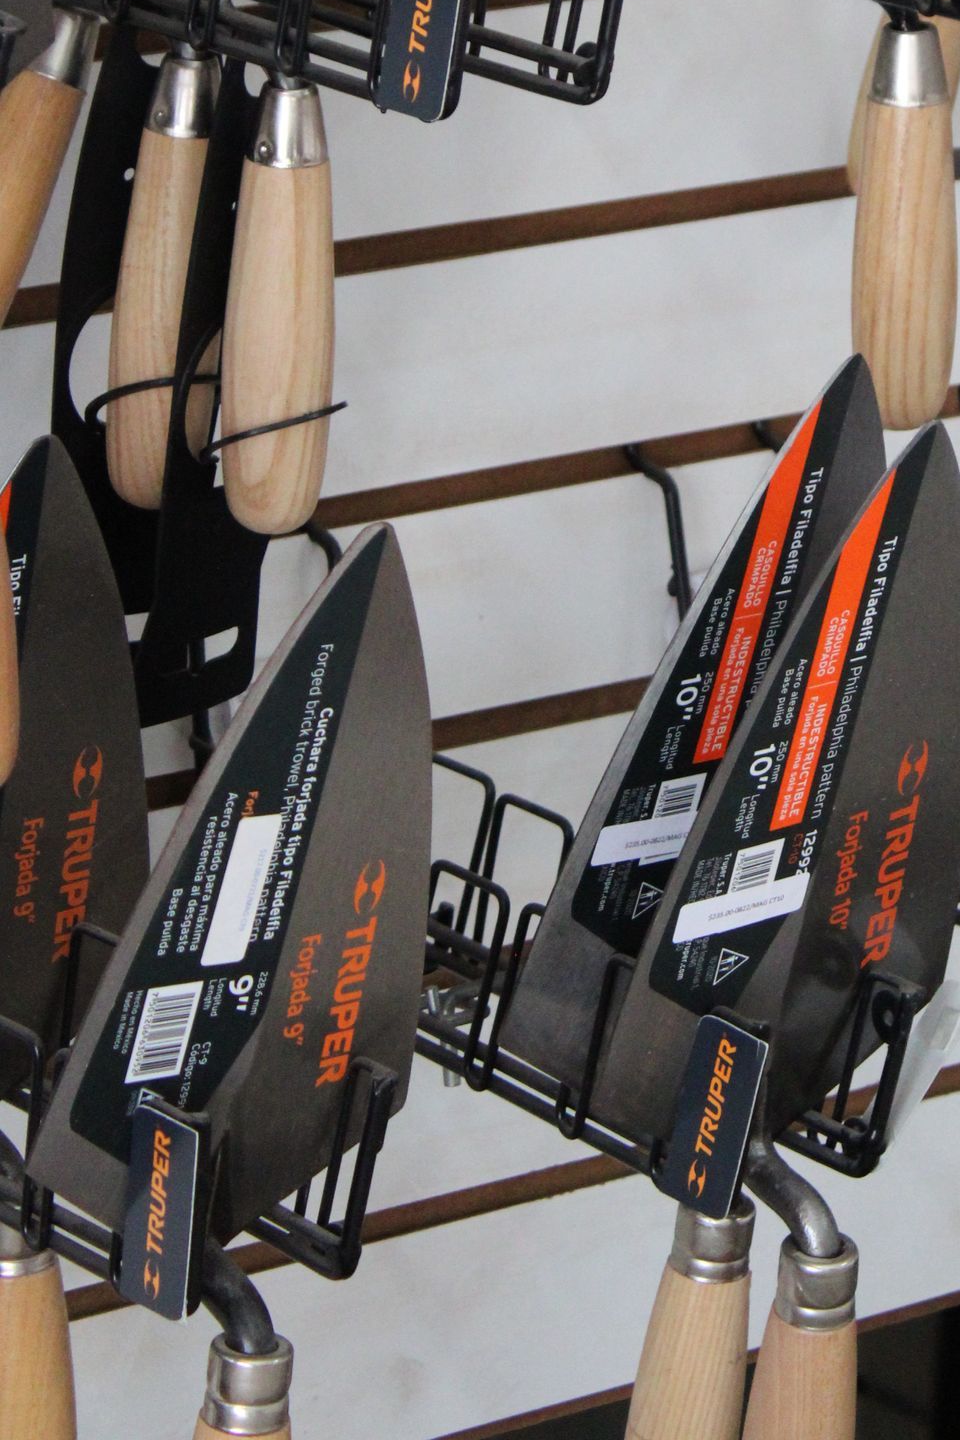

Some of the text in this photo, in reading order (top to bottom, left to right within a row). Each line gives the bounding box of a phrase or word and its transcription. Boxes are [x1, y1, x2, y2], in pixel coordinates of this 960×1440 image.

[799, 467, 824, 502] Tipo
[741, 547, 767, 607] CRIMPADO
[751, 541, 778, 605] CASQUILLO
[778, 511, 812, 582] Filadelfia
[697, 598, 723, 656] Base pulida
[708, 589, 736, 653] Acero aleado
[815, 617, 840, 676] CRIMPADO
[825, 609, 851, 674] CASQUILLO
[310, 643, 335, 696] Forged
[693, 672, 714, 713] 250 mm
[699, 627, 744, 753] Forjada en una sola pieza
[716, 634, 754, 753] INDESTRUCTIBLE
[770, 669, 795, 727] Base pulida
[782, 659, 808, 724] Acero aleado
[808, 536, 899, 818] Tipo Filadelfia Philadelphia pattern
[297, 701, 320, 736] brick
[659, 727, 675, 764] Length
[665, 724, 683, 770] Longitud
[283, 742, 309, 791] trowel,
[769, 740, 789, 783] 250 mm
[775, 696, 819, 818] Forjada en una sola pieza
[788, 705, 827, 817] INDESTRUCTIBLE
[262, 708, 334, 939] Cuchara forjada tipo Filadelfia
[734, 796, 750, 833] Length
[741, 794, 760, 839] Longitud
[13, 816, 46, 898] Forjada
[173, 816, 219, 952] resistencia al desgaste
[187, 793, 238, 950] Acero aleado para máxima
[833, 809, 869, 899] Forjada
[860, 794, 921, 969] TRUPER
[154, 888, 183, 955] Base pulida
[203, 980, 217, 1011] Length
[213, 978, 227, 1017] Longitud
[249, 997, 259, 1015] mm
[288, 932, 323, 1026] Forjada
[315, 918, 379, 1089] TRUPER
[111, 991, 133, 1049] Made in Mexico
[120, 990, 143, 1053] Hecho en México
[186, 1043, 200, 1079] Código:
[200, 1042, 211, 1065] CT-9
[693, 1038, 737, 1158] TRUPER
[146, 1128, 172, 1254] TRUPER
